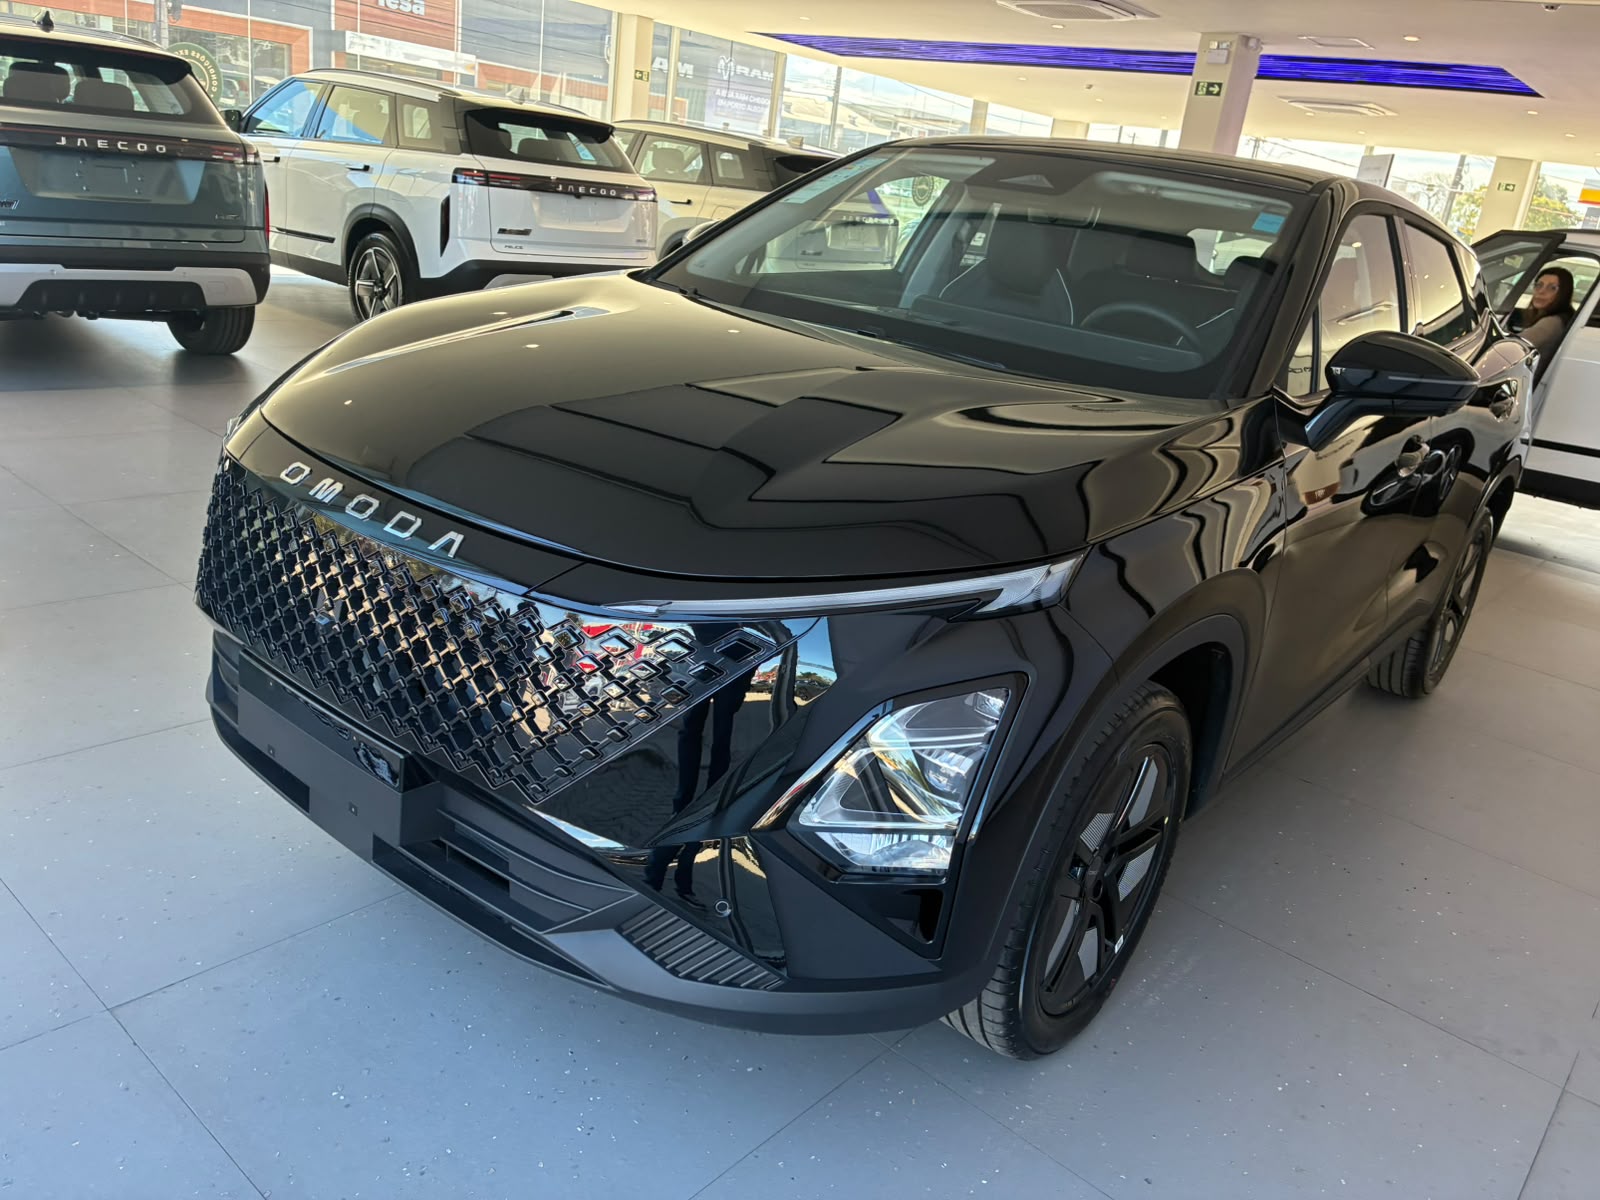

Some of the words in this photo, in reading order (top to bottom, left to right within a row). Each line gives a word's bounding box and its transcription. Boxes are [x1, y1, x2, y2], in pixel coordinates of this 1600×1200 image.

[56, 136, 167, 154] JAECOO
[556, 184, 617, 197] JAECOO
[279, 461, 465, 558] OMODA
